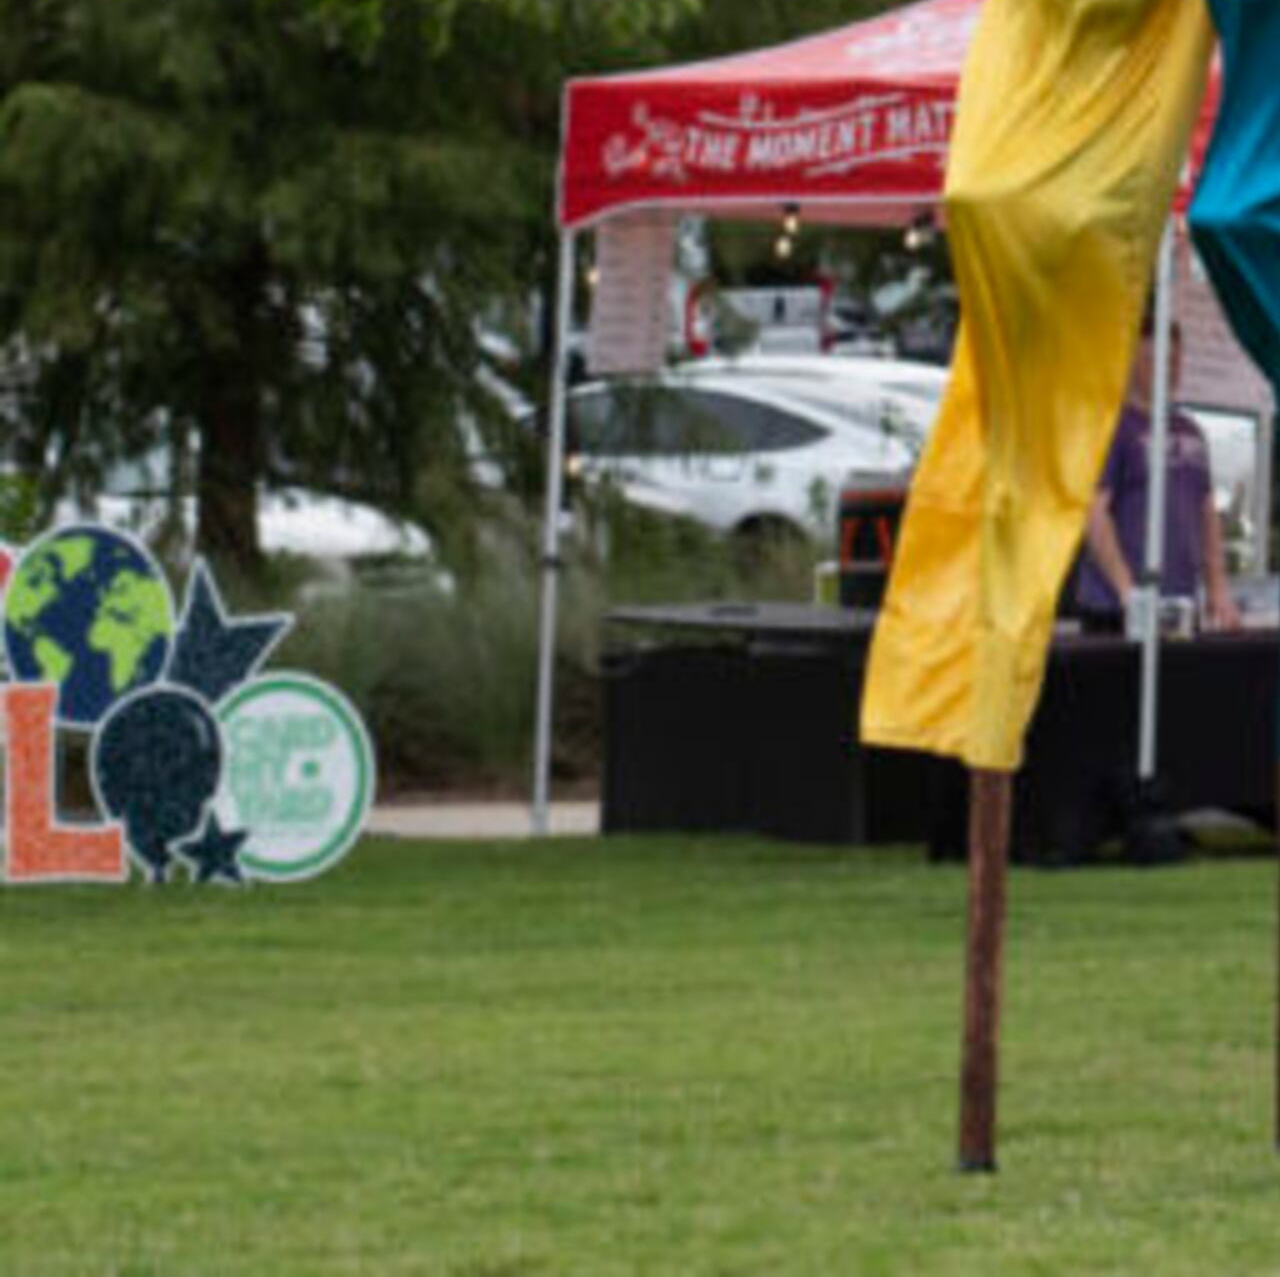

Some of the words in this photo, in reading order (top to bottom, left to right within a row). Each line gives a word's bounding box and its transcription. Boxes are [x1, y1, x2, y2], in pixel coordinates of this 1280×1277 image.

[686, 125, 740, 170] THE
[745, 111, 875, 170] MOMENT
[885, 100, 956, 144] MAT
